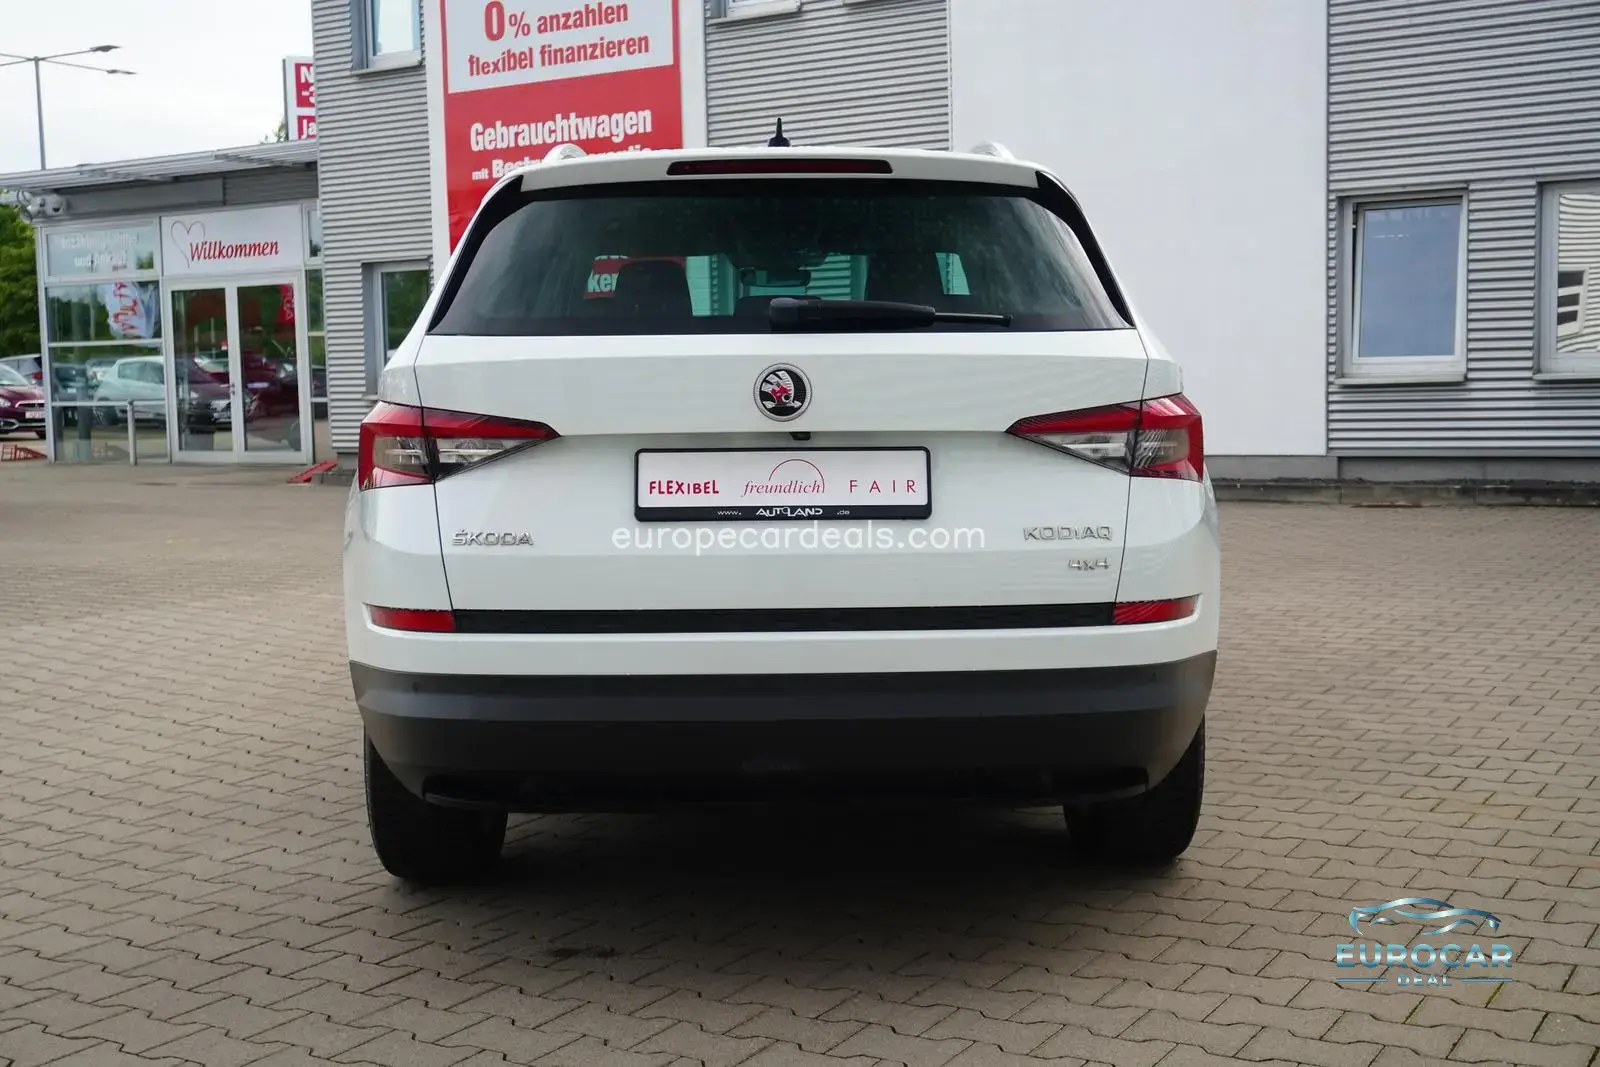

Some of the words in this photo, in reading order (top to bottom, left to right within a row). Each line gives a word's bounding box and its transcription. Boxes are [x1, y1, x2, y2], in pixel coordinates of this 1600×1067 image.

[537, 2, 628, 34] anzahlen
[468, 47, 534, 77] flexibel
[540, 35, 649, 67] finanzieren
[470, 109, 652, 151] Gebrauchtwagen
[472, 168, 489, 180] mit
[189, 240, 280, 261] Willkommen
[649, 480, 719, 495] FLEXIBEL
[740, 480, 821, 497] freundlich
[756, 507, 823, 517] AUTOLAND
[452, 528, 534, 546] ŠKODA
[1023, 526, 1112, 541] KODIAQ
